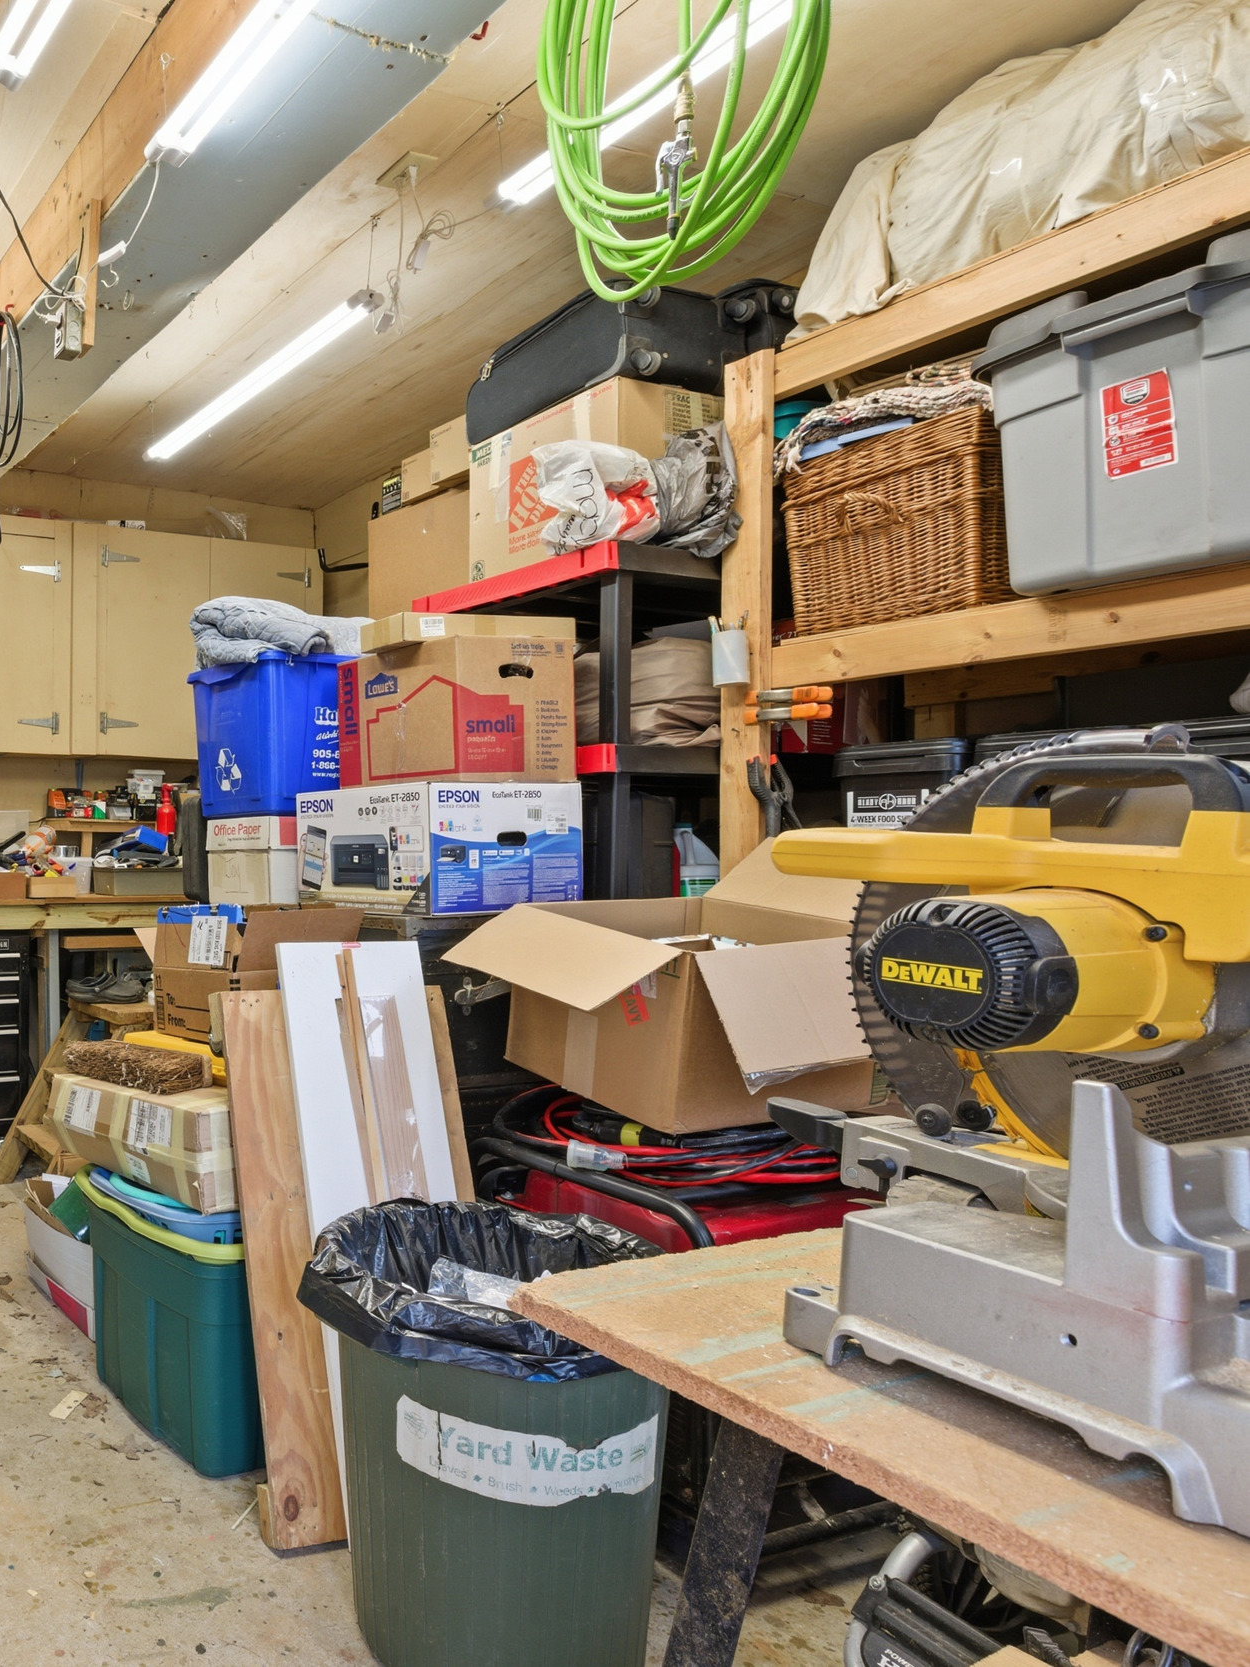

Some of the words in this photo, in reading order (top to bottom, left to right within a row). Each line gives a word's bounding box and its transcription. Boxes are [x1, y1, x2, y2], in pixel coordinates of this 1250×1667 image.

[513, 462, 537, 494] THE
[509, 475, 539, 530] HO
[367, 680, 395, 696] LOWE'S
[343, 667, 358, 736] small
[315, 706, 339, 726] Ha
[465, 714, 516, 734] small
[391, 791, 420, 803] ET-2850
[438, 790, 480, 803] EPSON
[492, 791, 513, 799] EcoTank
[514, 790, 542, 799] ET-2850
[300, 799, 334, 814] EPSON
[851, 815, 877, 823] 4-WEEK
[877, 815, 896, 823] FOOD
[213, 824, 236, 836] Office
[238, 823, 262, 838] Paper
[439, 1427, 512, 1466] Yard
[524, 1445, 624, 1473] Waste
[488, 1476, 523, 1492] Brush
[544, 1485, 583, 1497] Weeds
